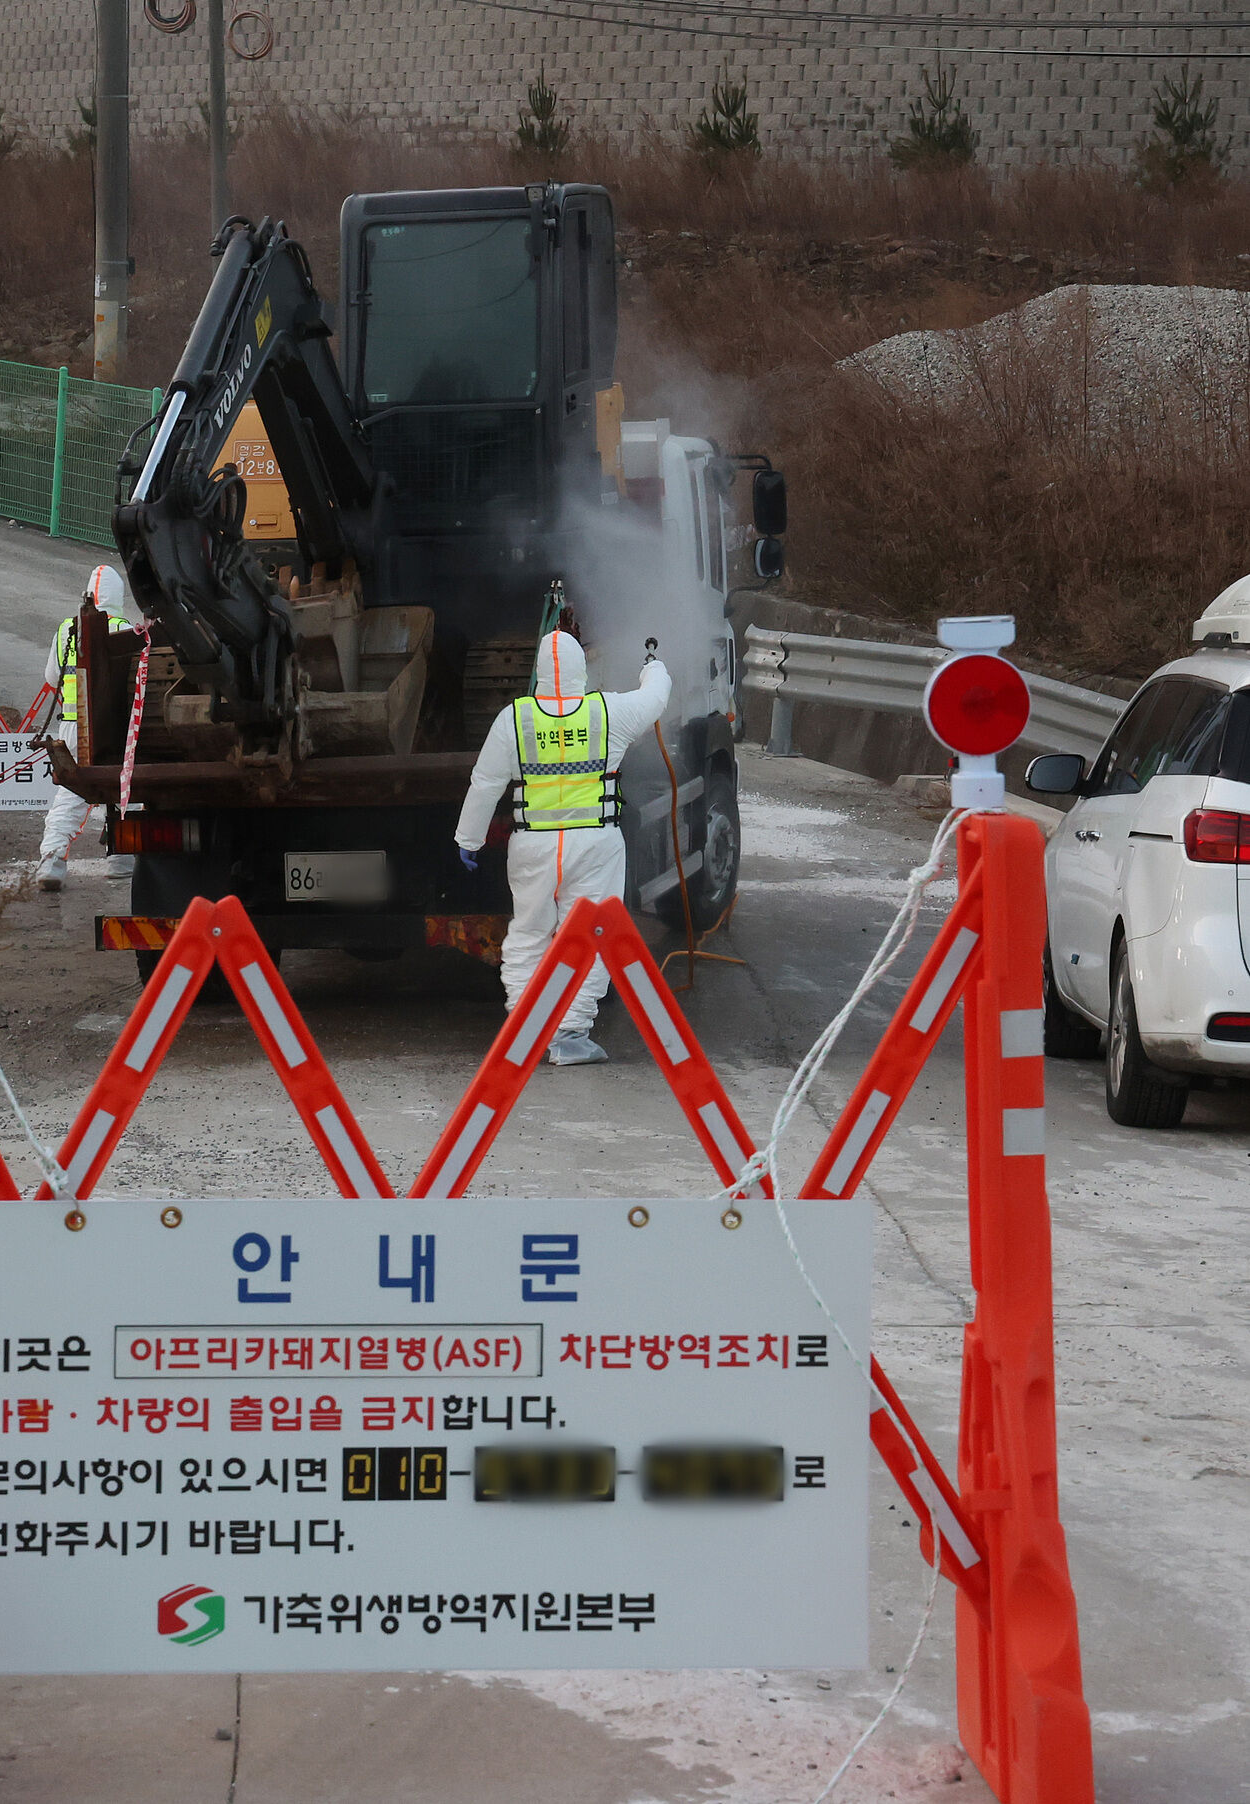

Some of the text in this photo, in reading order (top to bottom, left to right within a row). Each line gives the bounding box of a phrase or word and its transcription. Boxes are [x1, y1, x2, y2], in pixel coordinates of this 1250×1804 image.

[214, 344, 252, 429] VOLVO
[236, 460, 281, 476] 02보8
[536, 728, 588, 749] 방역본부
[131, 1336, 523, 1373] 아프리카돼지열병(ASF)
[561, 1334, 829, 1371] 차단방역조치로
[97, 1397, 210, 1434] 차량의
[230, 1396, 344, 1433] 출입을
[362, 1395, 566, 1432] 금지합니다.
[181, 1458, 328, 1495] 있으시면
[190, 1520, 355, 1556] 바랍니다.
[245, 1592, 657, 1636] 가축위생방역지원본부
